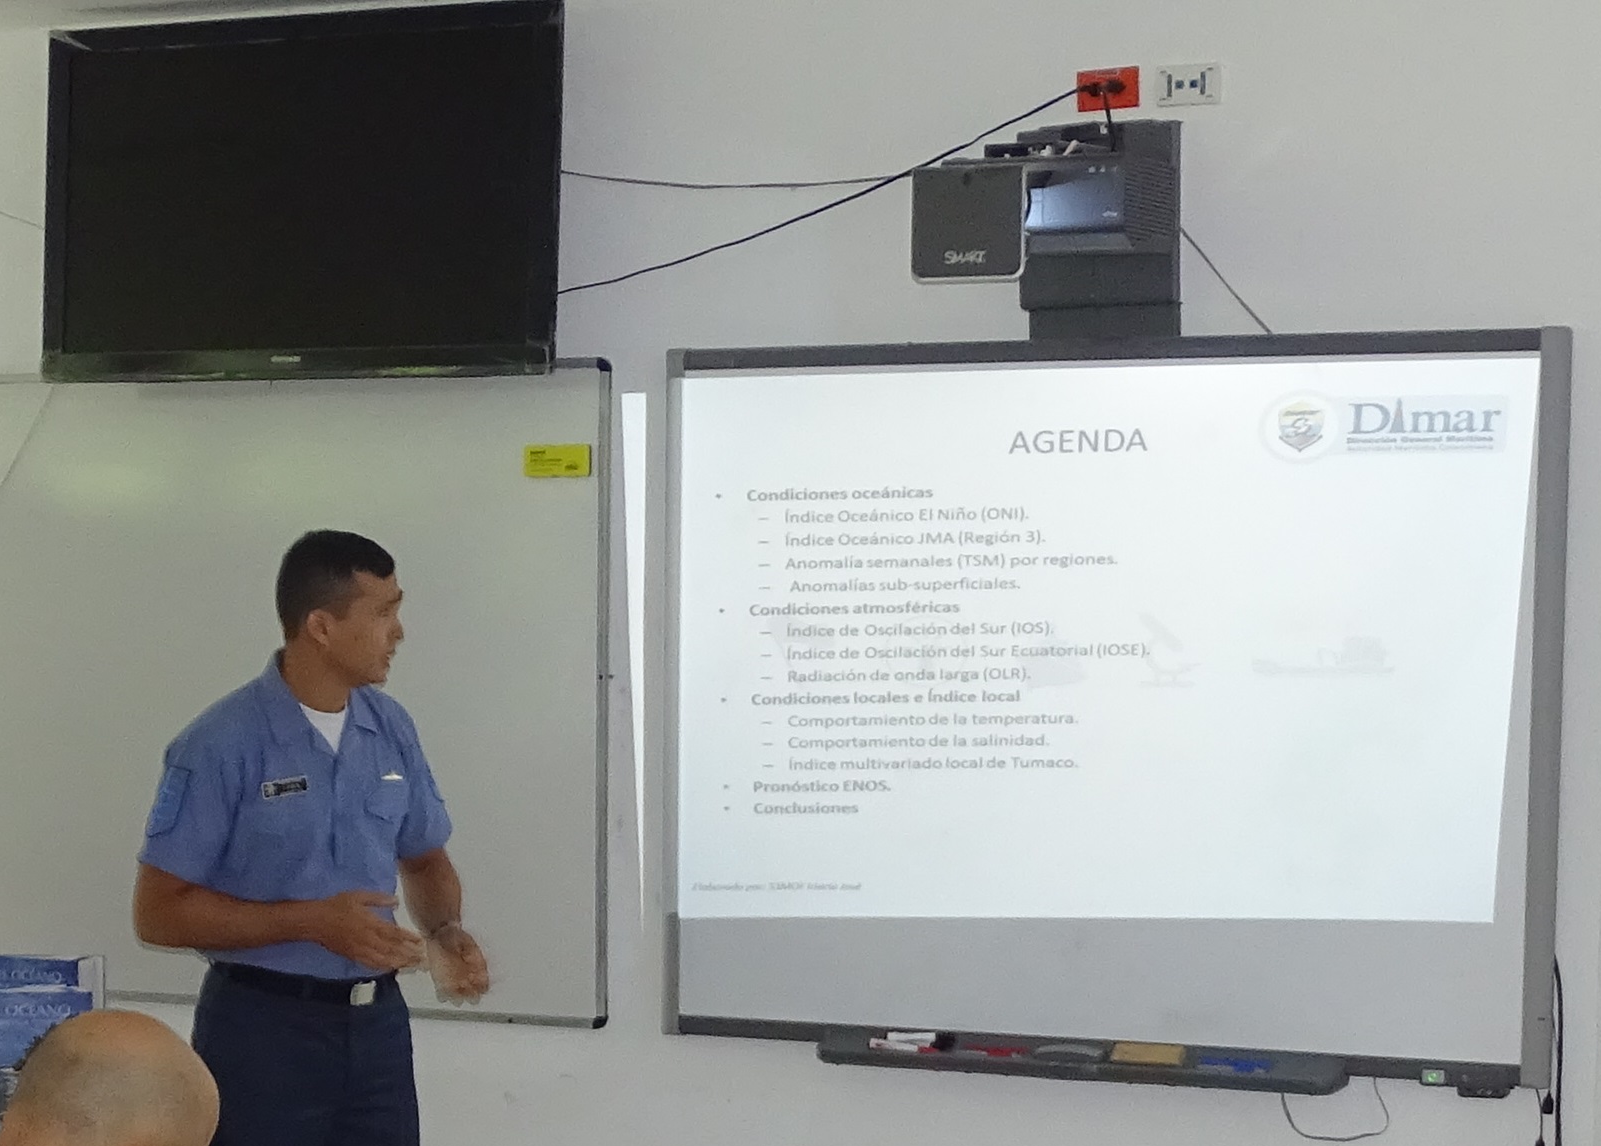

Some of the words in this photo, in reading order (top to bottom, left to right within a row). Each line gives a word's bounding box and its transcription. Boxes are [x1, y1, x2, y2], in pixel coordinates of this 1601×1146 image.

[943, 250, 987, 265] SMART
[1347, 397, 1502, 434] Dimar
[1008, 428, 1148, 454] AGENDA
[746, 488, 848, 502] Condiciones
[851, 486, 934, 499] oceánicas
[784, 508, 835, 524] Índice
[837, 508, 915, 523] Oceánico
[919, 508, 935, 521] El
[937, 506, 978, 521] Niño
[981, 505, 1030, 523] (ONI).
[784, 531, 835, 547] Índice
[837, 531, 914, 546] Oceánico
[917, 531, 955, 546] JMA
[958, 529, 1022, 547] (Región
[1025, 529, 1046, 546] 3).
[784, 555, 864, 570] Anomalía
[866, 555, 953, 569] semanales
[957, 553, 1007, 570] (TSM)
[1010, 554, 1040, 569] por
[1042, 552, 1119, 568] regiones.
[789, 578, 877, 593] Anomalías
[879, 576, 1022, 594] sub-superficiales.
[749, 603, 850, 618] Condiciones
[852, 601, 961, 617] atmosféricas
[786, 623, 836, 638] Índice
[838, 624, 860, 638] de
[864, 622, 948, 637] Oscilación
[949, 622, 976, 636] del
[979, 622, 1008, 636] Sur
[1010, 620, 1055, 638] (IOS).
[786, 646, 837, 661] Índice
[839, 646, 861, 660] de
[864, 645, 948, 660] Oscilación
[949, 645, 977, 659] del
[979, 644, 1008, 658] Sur
[1010, 643, 1093, 658] Ecuatorial
[1096, 642, 1152, 660] (IOSE).
[787, 668, 867, 684] Radiación
[868, 669, 891, 683] de
[894, 668, 937, 683] onda
[939, 667, 980, 686] larga
[982, 666, 1032, 684] (OLR).
[750, 692, 851, 708] Condiciones
[853, 691, 911, 707] locales
[914, 693, 924, 704] e
[926, 689, 978, 705] Índice
[981, 689, 1022, 704] local
[787, 714, 926, 731] Comportamiento
[928, 713, 950, 728] de
[953, 713, 968, 727] la
[971, 713, 1080, 730] temperatura.
[787, 736, 926, 753] Comportamiento
[928, 735, 950, 749] de
[953, 735, 968, 749] la
[971, 734, 1051, 749] salinidad.
[788, 757, 838, 772] Índice
[840, 757, 943, 772] multivariado
[944, 756, 983, 771] local
[985, 756, 1007, 770] de
[1009, 756, 1080, 770] Tumaco.
[752, 780, 840, 795] Pronóstico
[842, 779, 893, 795] ENOS.
[753, 801, 859, 816] Conclusiones
